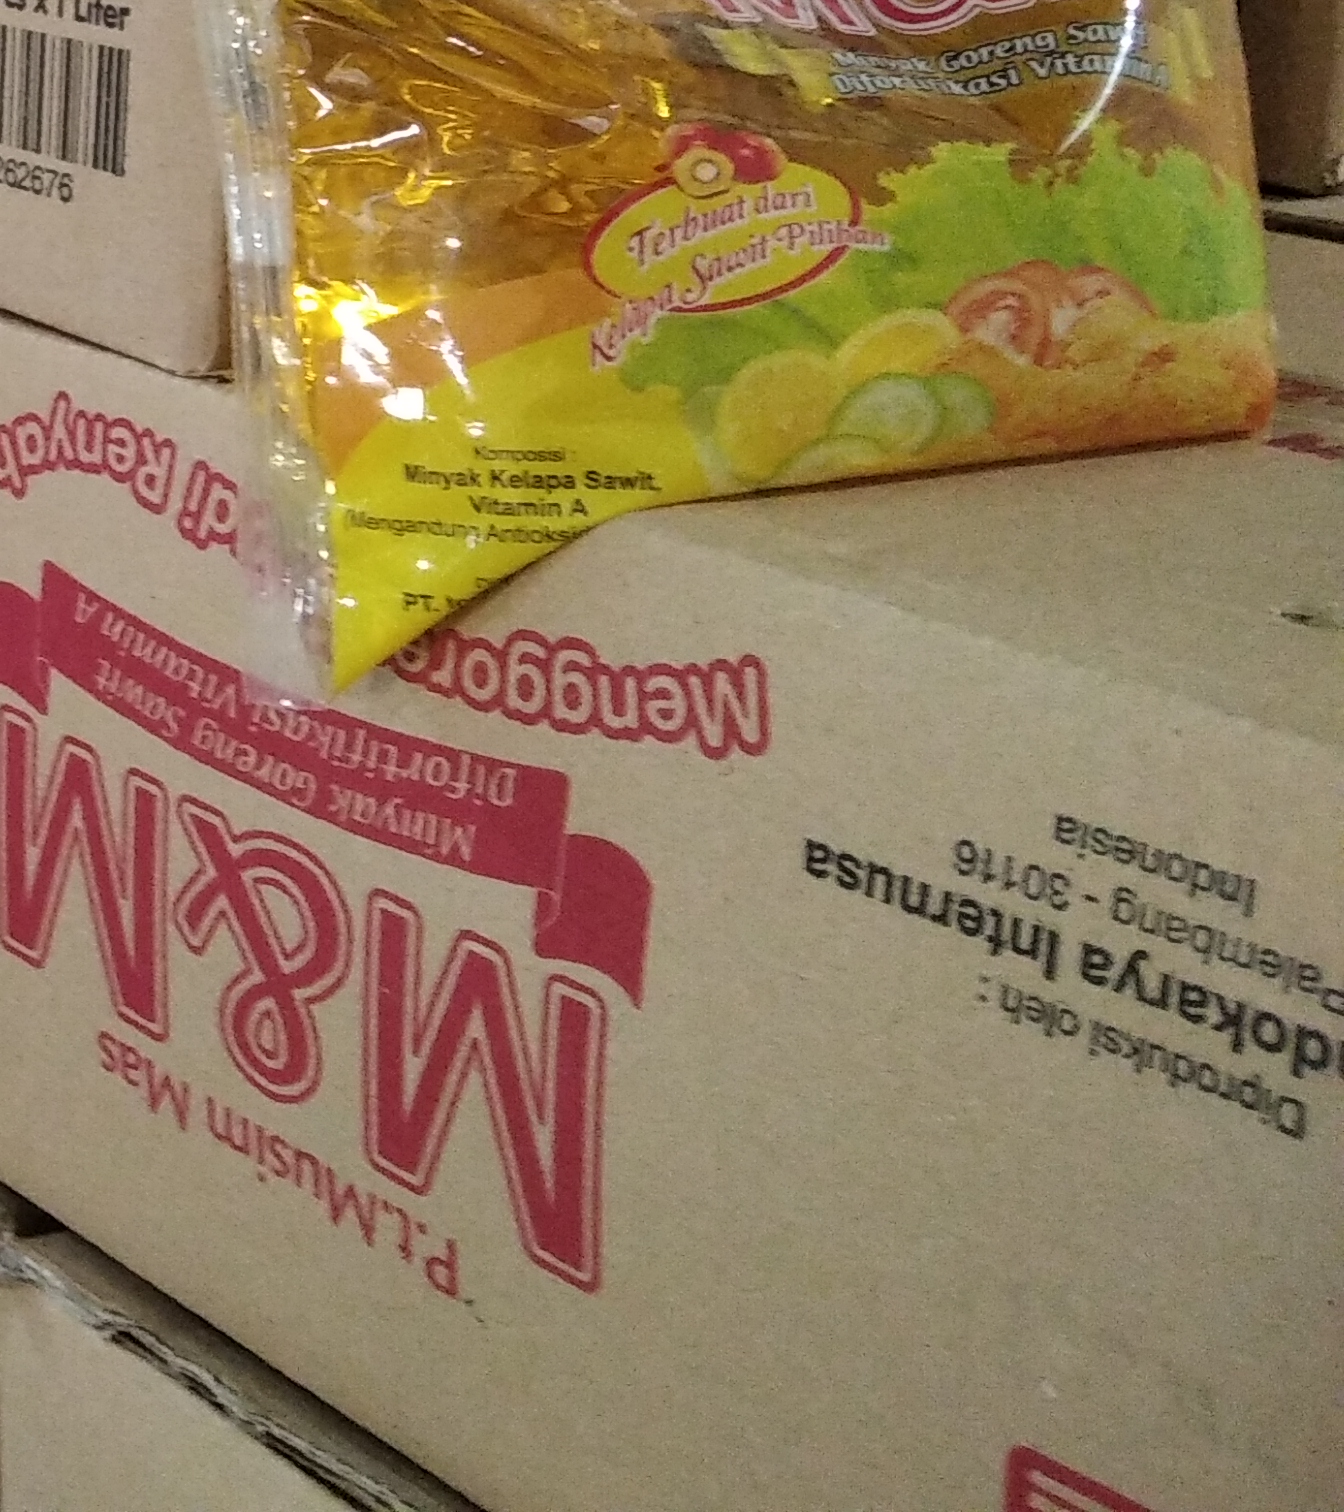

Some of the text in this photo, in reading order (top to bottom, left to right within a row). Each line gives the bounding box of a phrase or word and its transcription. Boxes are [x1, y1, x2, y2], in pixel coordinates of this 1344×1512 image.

[939, 29, 1058, 73] Goreng
[626, 182, 817, 270] Terbuat dari
[678, 233, 769, 307] Sawit
[402, 463, 483, 491] Minyak
[490, 468, 577, 495] Kelapa
[468, 494, 590, 518] Vitamin A
[70, 592, 518, 810] Difortifikasi Vitamin A
[376, 629, 770, 760] Menggore
[93, 655, 478, 862] Minyak Goreng Sawit
[803, 836, 1064, 982] Internusa
[952, 838, 1072, 914] 30116
[1052, 813, 1259, 920] Indonesia
[998, 980, 1083, 1040] oleh
[1088, 1025, 1307, 1141] Diproduksi
[98, 1030, 461, 1299] P.t.Musim Mas
